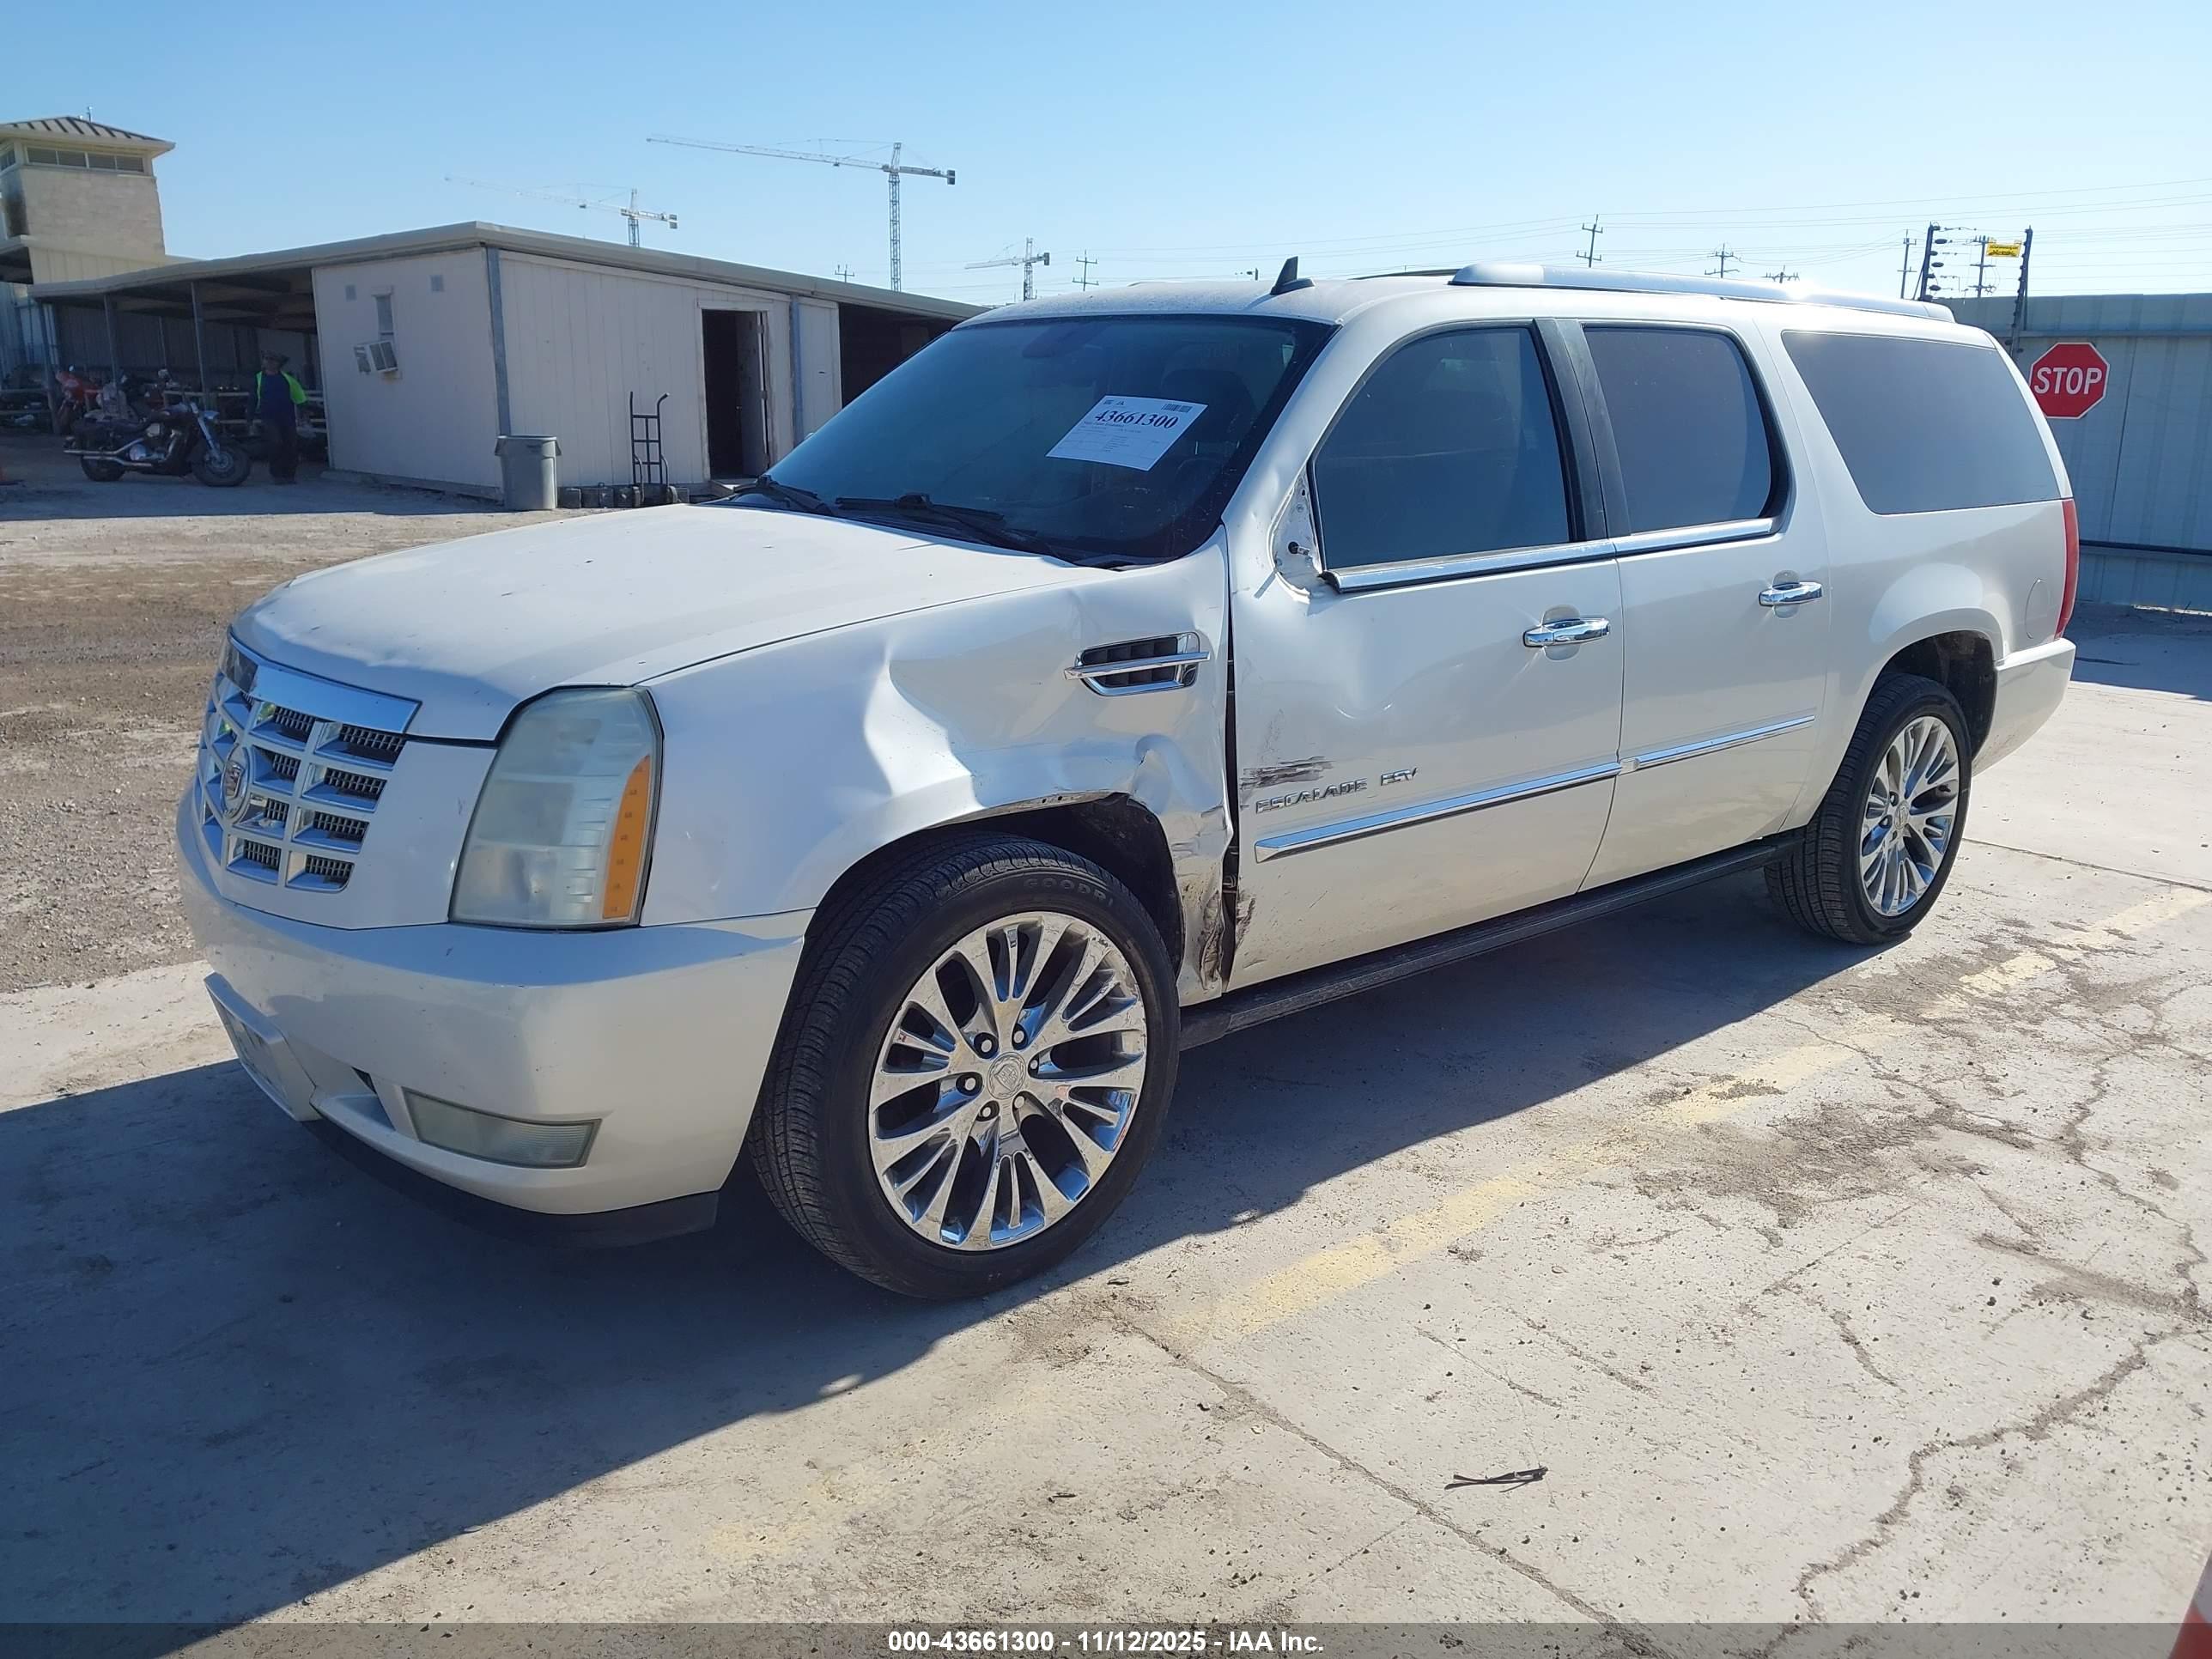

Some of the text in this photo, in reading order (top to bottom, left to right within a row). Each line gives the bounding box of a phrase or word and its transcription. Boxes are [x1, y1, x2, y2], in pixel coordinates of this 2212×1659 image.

[2033, 367, 2103, 394] STOP
[1094, 410, 1179, 429] 43661300
[1255, 767, 1420, 814] ESCALADE ESV
